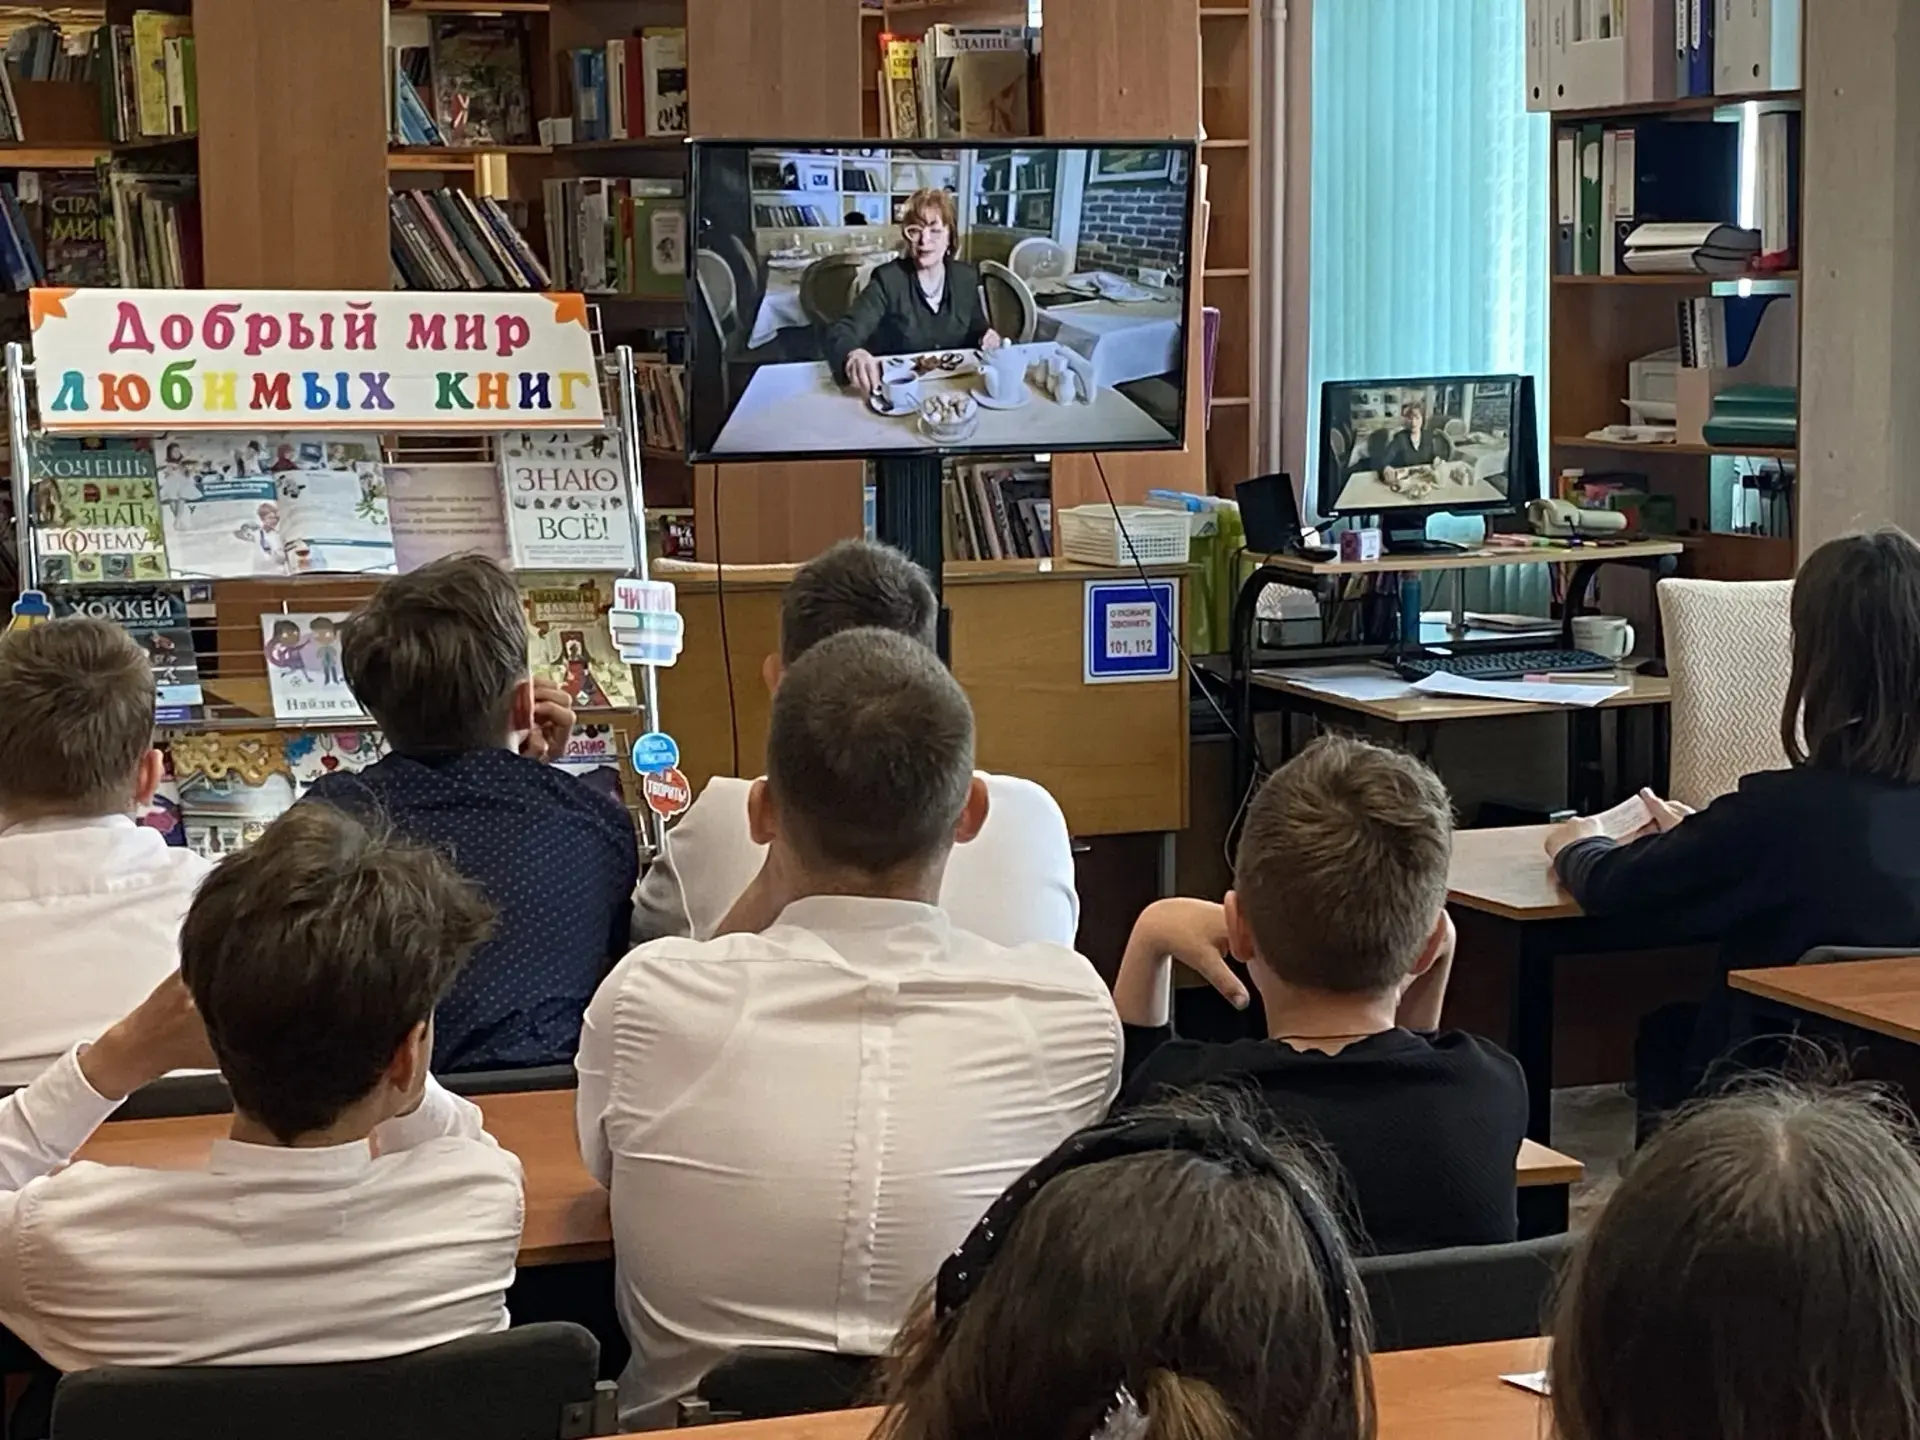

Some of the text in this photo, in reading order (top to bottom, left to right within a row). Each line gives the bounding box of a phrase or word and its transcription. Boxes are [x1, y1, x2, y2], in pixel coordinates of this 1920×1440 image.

[108, 300, 531, 356] Добрый мир
[50, 358, 592, 412] любимых книг
[39, 459, 148, 477] ХОЧЕШЬ
[515, 467, 619, 492] ЗНАЮ
[79, 502, 153, 526] ЗНАТЬ
[537, 513, 610, 541] ВСЁ!
[69, 595, 172, 620] ХОККЕЙ
[617, 586, 672, 612] ЧИТАЙ
[1110, 639, 1153, 654] 101, 112
